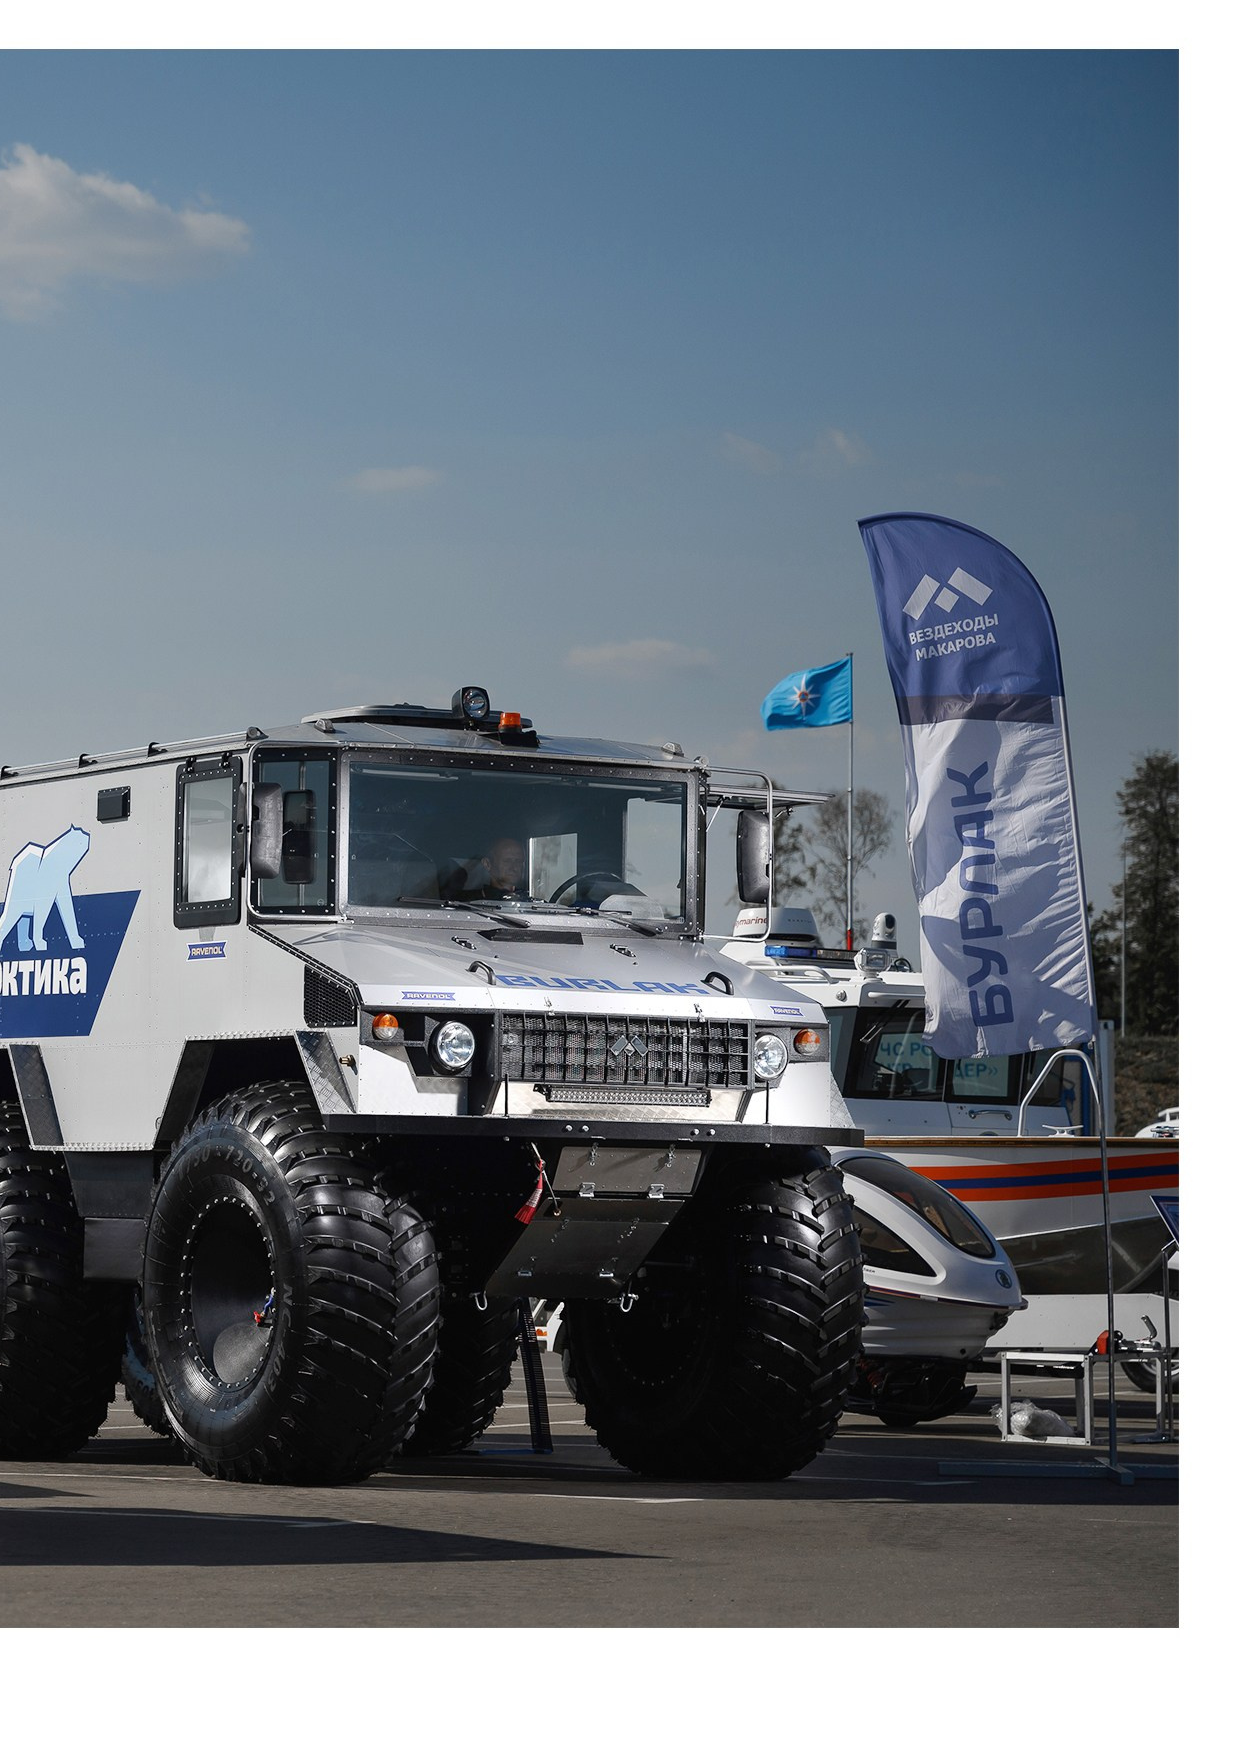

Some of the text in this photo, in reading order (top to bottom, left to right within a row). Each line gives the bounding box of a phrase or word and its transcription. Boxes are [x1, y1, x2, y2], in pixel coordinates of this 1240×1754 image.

[909, 613, 999, 645] ВЕЗДЕХОДЫ
[915, 632, 996, 661] МАКАРОВА
[946, 761, 1014, 1027] БУРЛАК
[191, 946, 223, 956] RAVENOL
[495, 975, 710, 995] BURLAK
